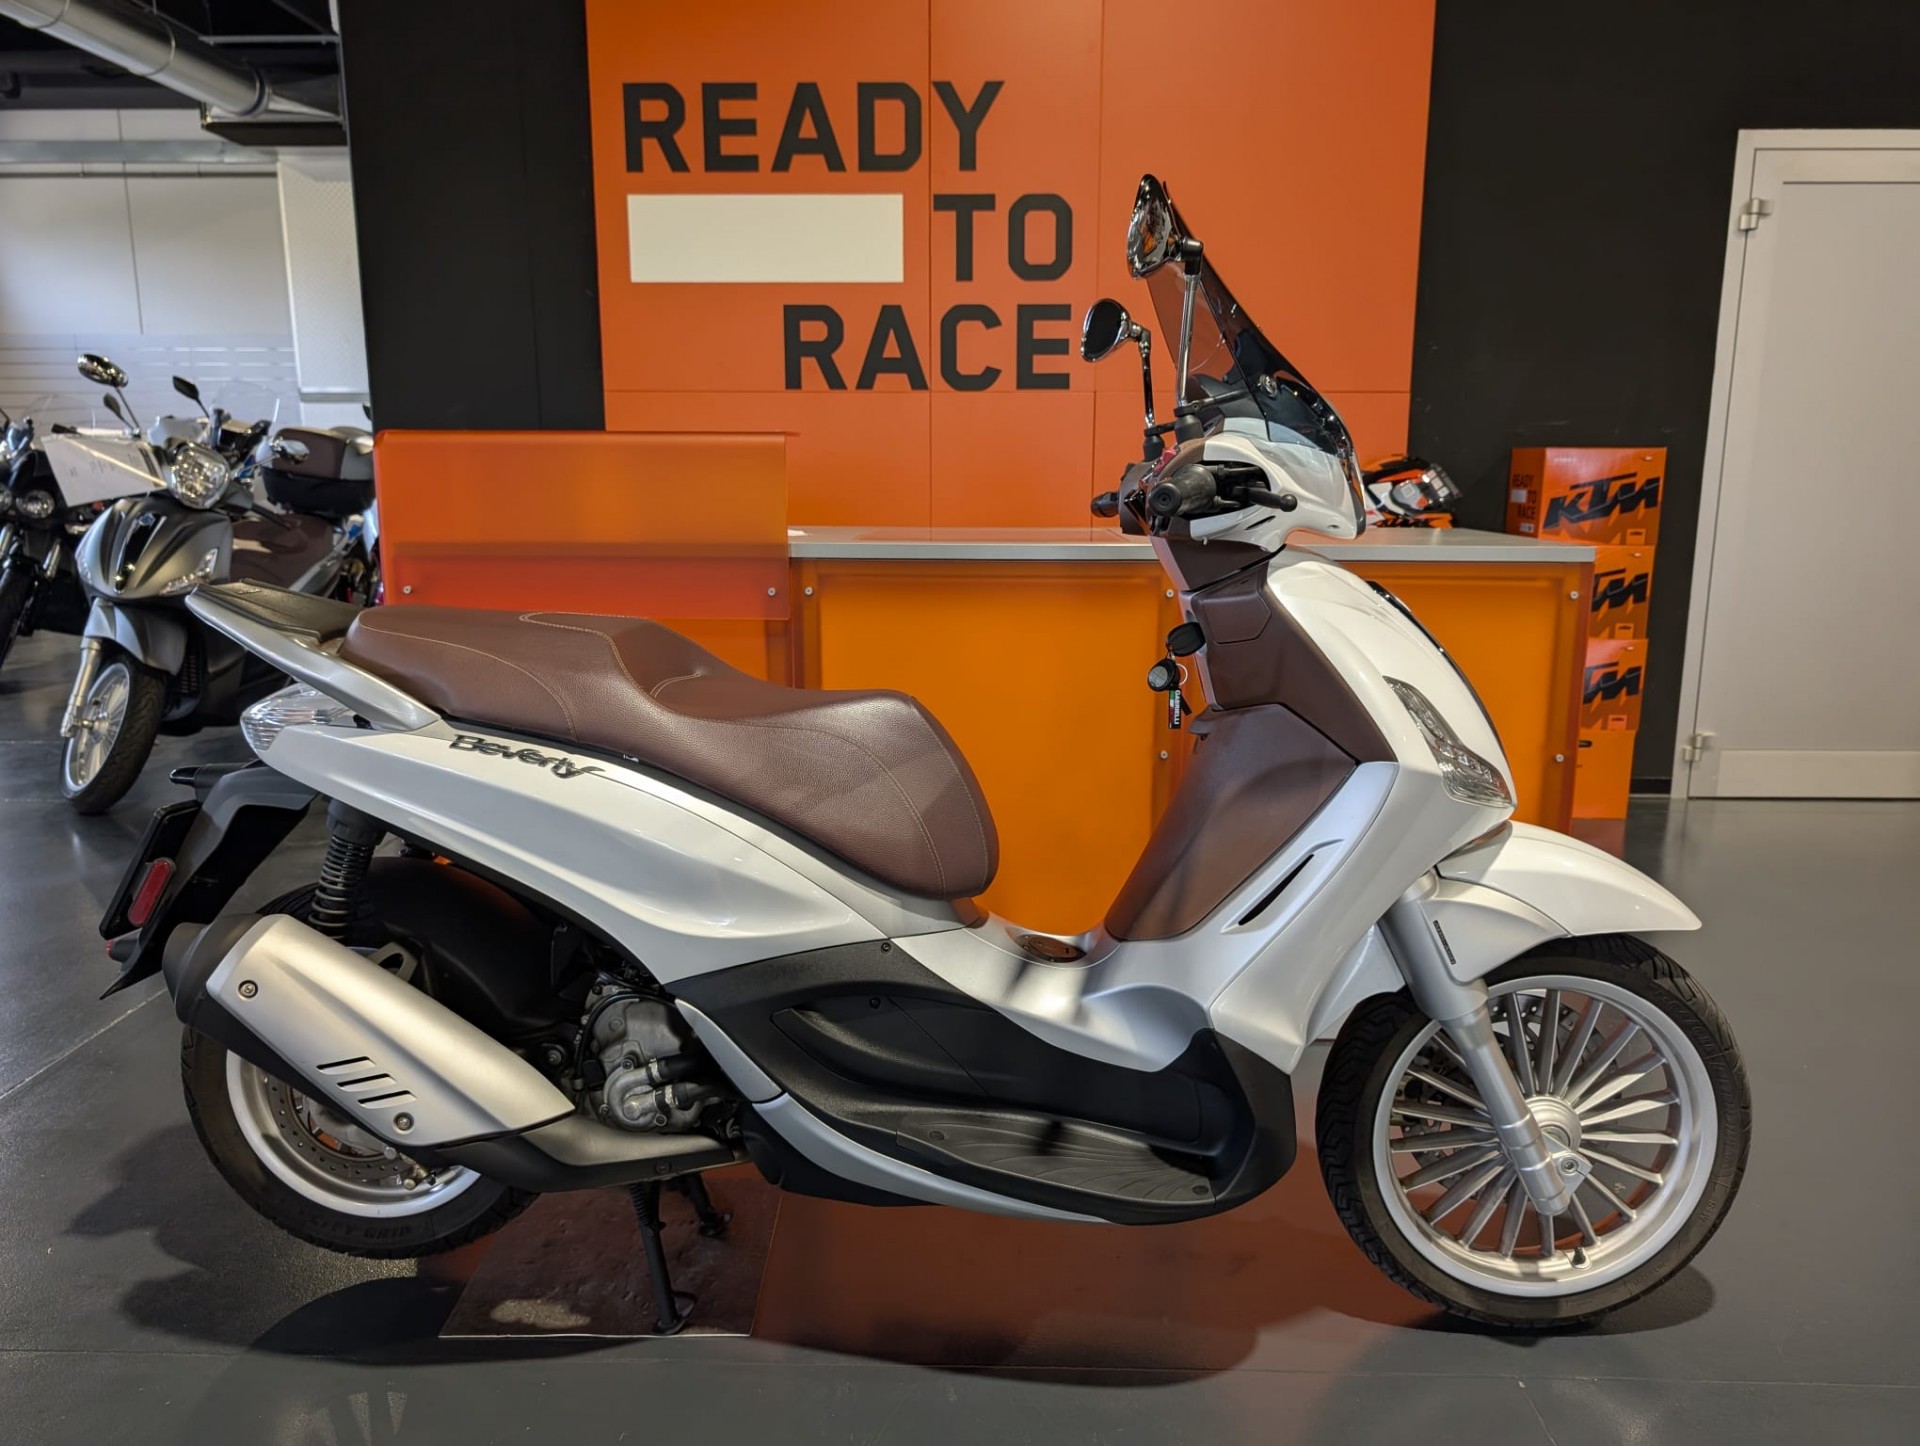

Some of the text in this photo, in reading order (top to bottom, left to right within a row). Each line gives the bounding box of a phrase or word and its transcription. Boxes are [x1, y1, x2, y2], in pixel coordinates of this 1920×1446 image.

[622, 81, 1004, 173] READY
[933, 193, 1073, 282] TO
[783, 304, 1072, 391] RACE
[1512, 473, 1535, 488] READY
[1527, 489, 1537, 504] TO
[1543, 472, 1661, 529] KTM
[1517, 504, 1536, 520] RACE
[449, 733, 606, 779] Beverly
